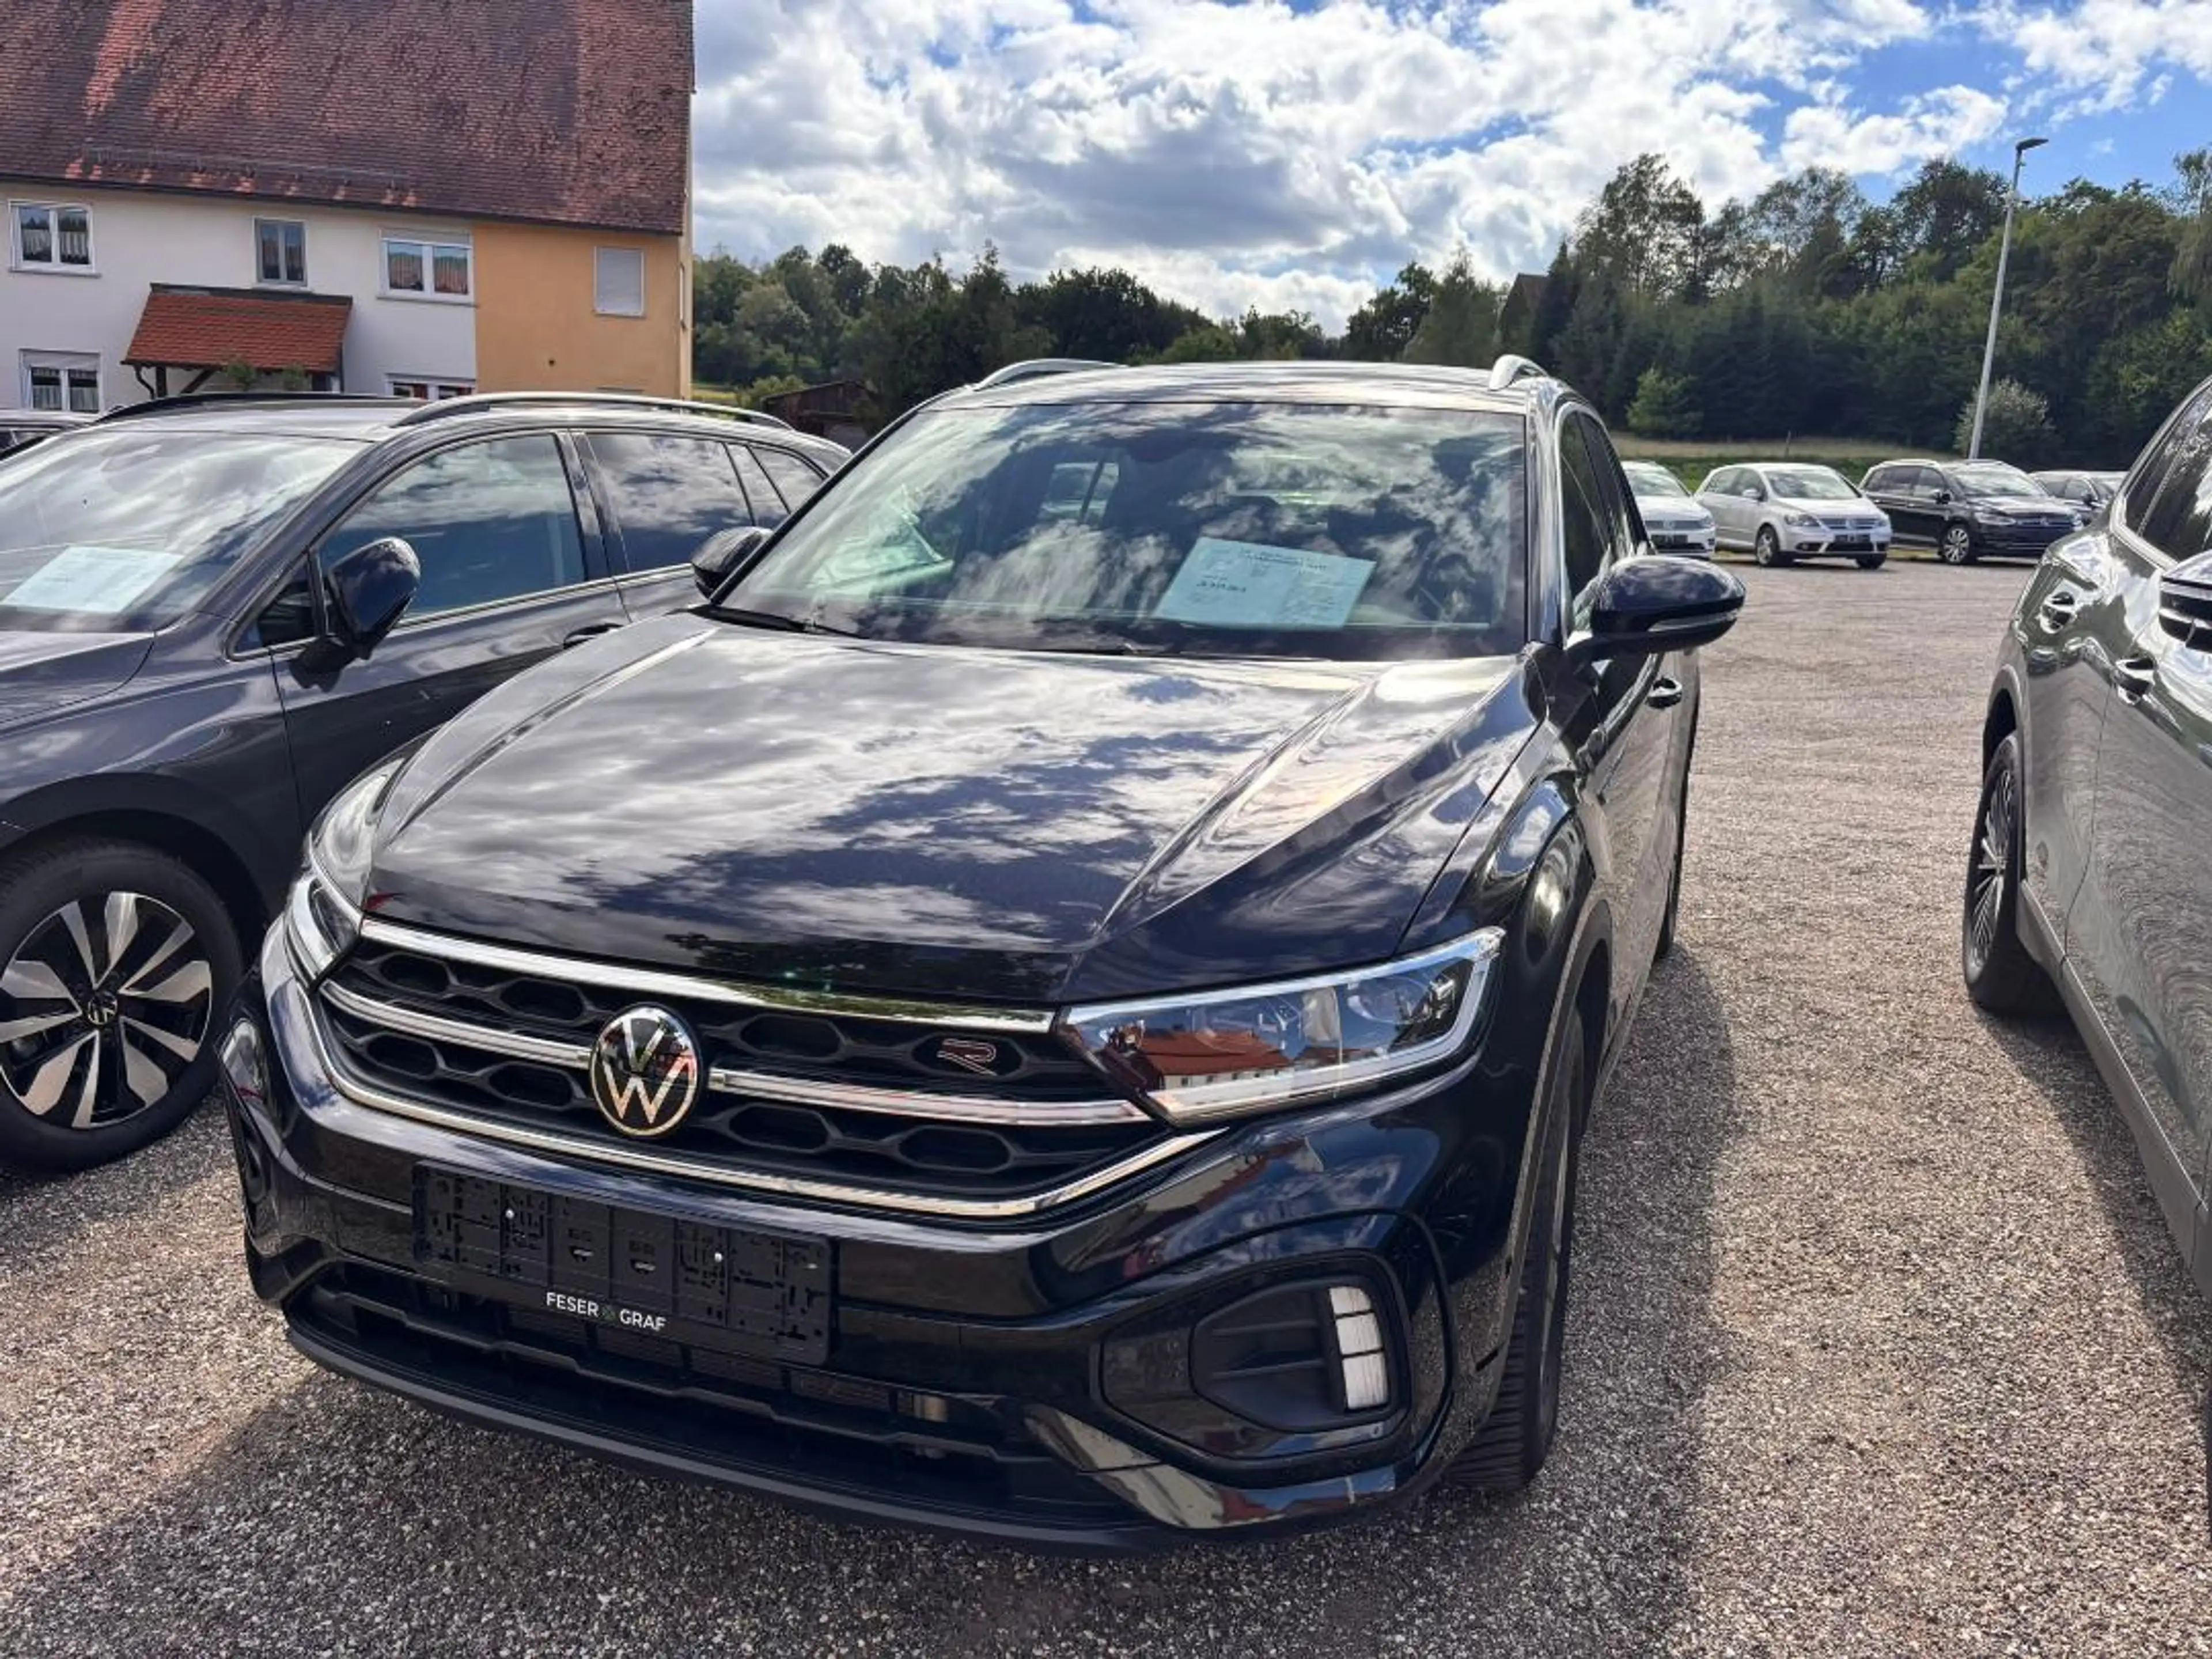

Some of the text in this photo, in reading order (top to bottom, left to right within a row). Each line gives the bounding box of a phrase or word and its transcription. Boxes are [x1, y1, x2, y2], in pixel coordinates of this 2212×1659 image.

[600, 1012, 697, 1127] VW
[546, 1292, 667, 1331] FESER GRAF
